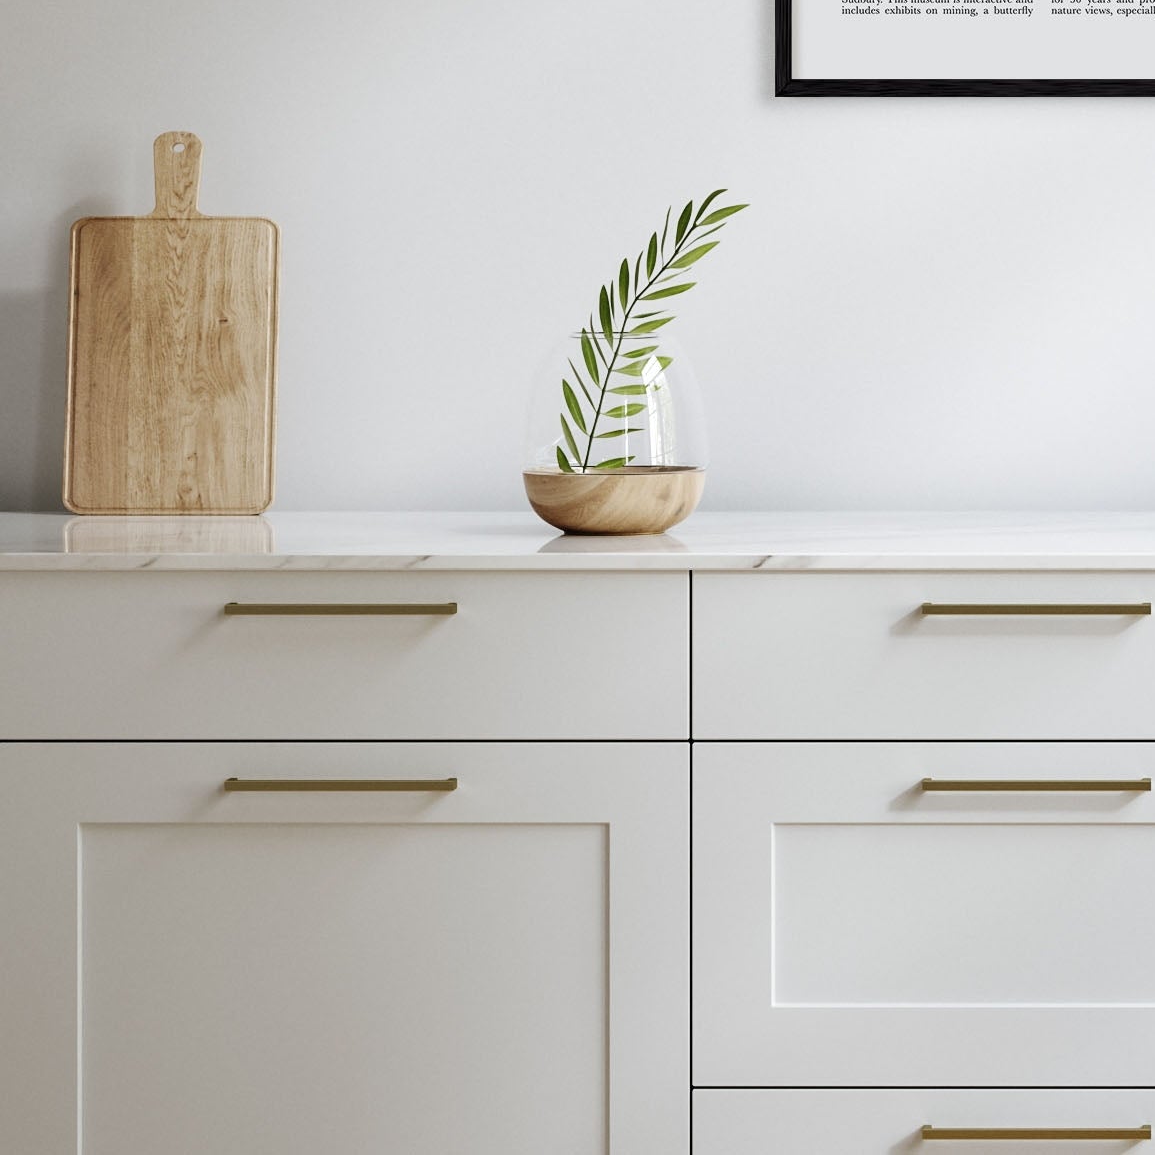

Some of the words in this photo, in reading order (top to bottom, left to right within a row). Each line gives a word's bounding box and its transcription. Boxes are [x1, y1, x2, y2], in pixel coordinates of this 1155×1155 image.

[842, 6, 880, 14] includes
[884, 6, 921, 14] exhibits
[943, 6, 978, 16] mining,
[994, 6, 1034, 16] butterfly
[1051, 6, 1081, 14] nature
[1085, 6, 1113, 15] views,
